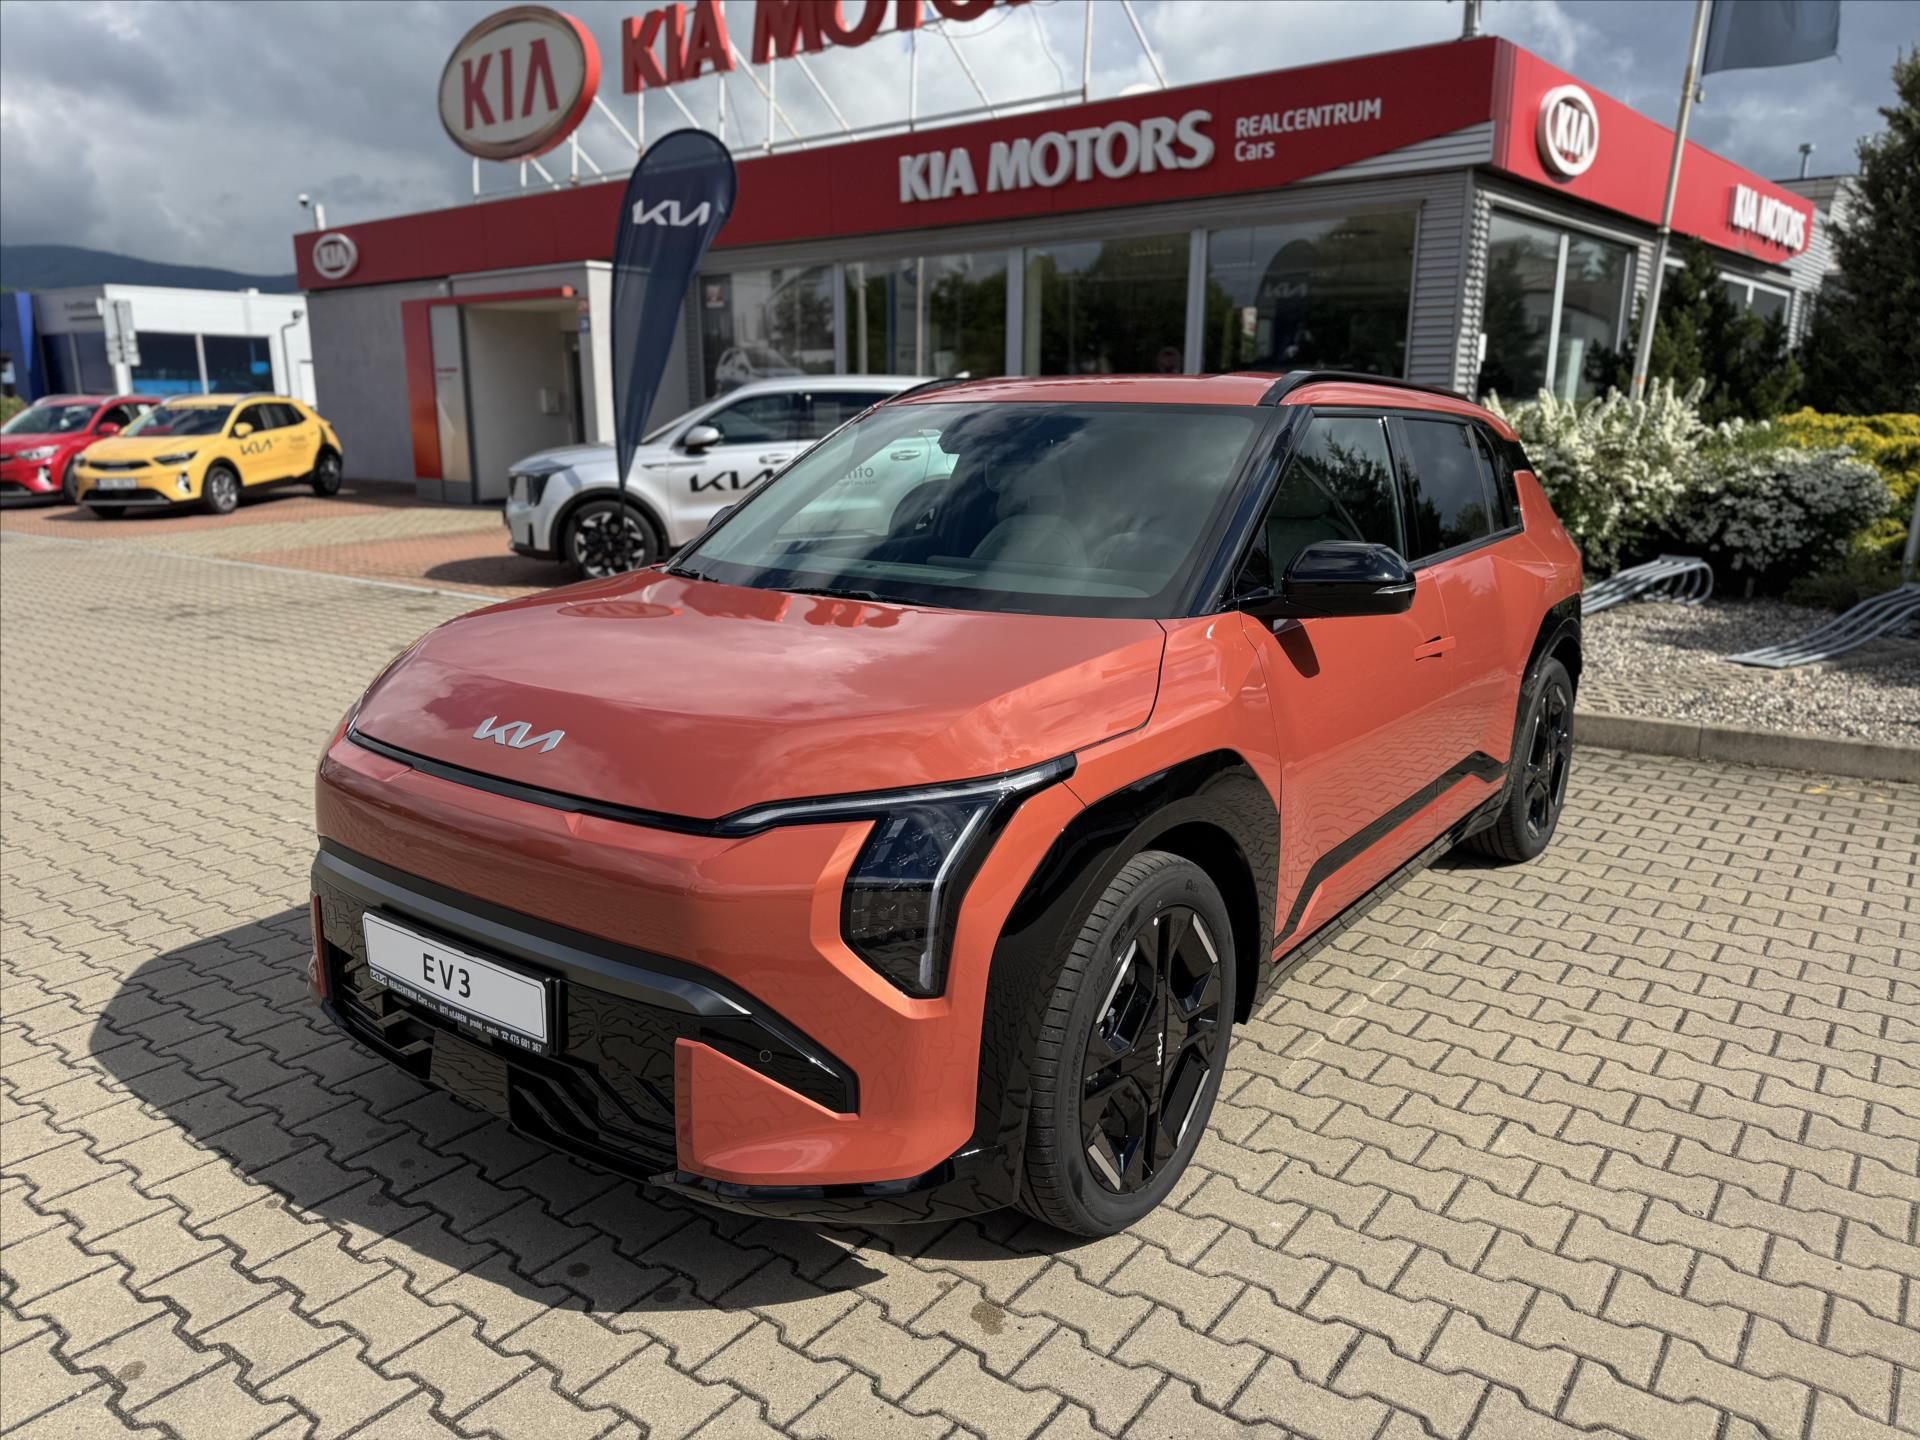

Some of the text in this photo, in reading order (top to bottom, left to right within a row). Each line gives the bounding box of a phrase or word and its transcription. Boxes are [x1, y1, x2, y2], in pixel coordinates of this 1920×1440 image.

[622, 0, 735, 94] KIA
[461, 37, 560, 131] KIA
[1234, 97, 1382, 139] REALCENTRUM
[1555, 101, 1591, 158] KIA
[899, 109, 1216, 203] KIA MOTORS
[1234, 140, 1276, 162] Cars
[632, 199, 711, 227] KIA
[1732, 182, 1807, 252] KIA MOTORS
[471, 714, 566, 755] KIA
[422, 952, 471, 999] EV3
